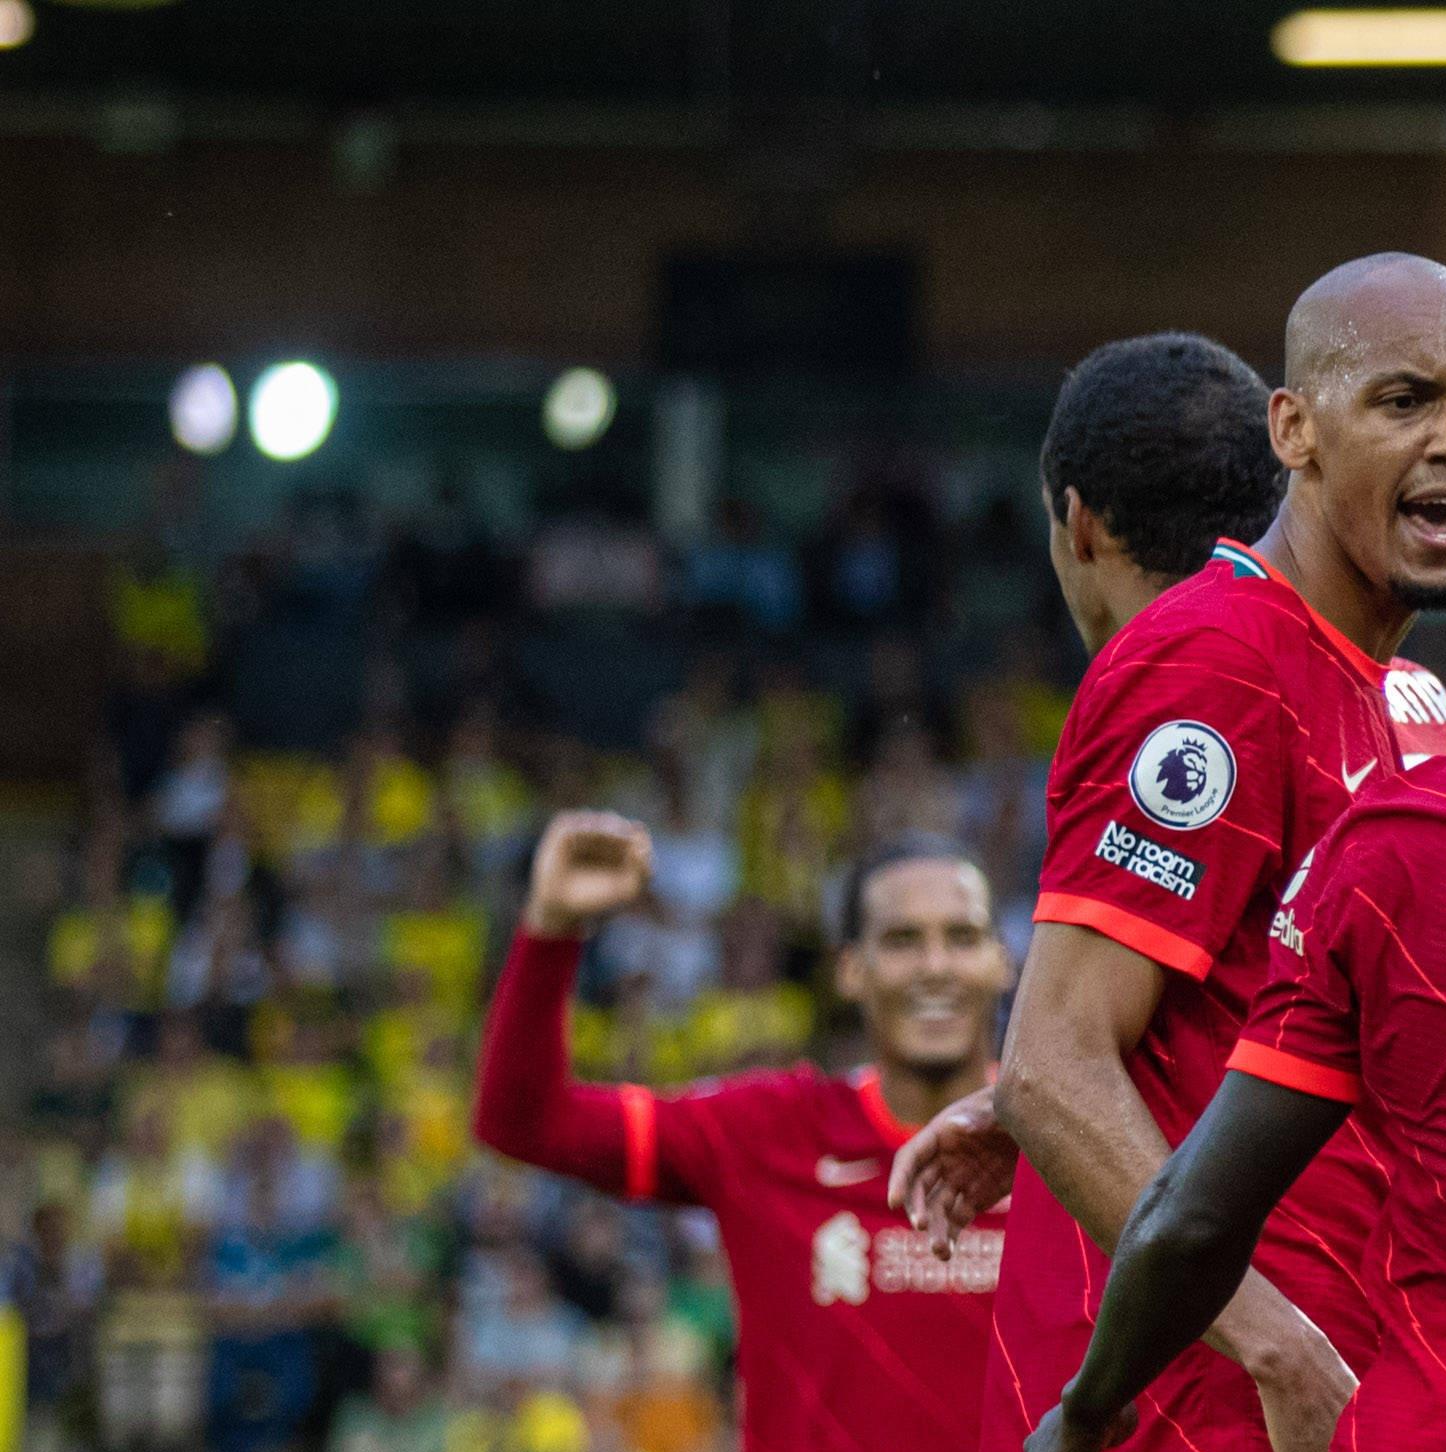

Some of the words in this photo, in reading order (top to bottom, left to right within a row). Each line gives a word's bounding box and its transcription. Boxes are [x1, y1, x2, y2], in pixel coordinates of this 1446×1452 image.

[1160, 803, 1194, 818] Premier
[1195, 787, 1219, 816] League
[1094, 838, 1130, 867] for
[1126, 855, 1198, 901] racism
[1102, 820, 1137, 850] No
[1138, 840, 1195, 880] room
